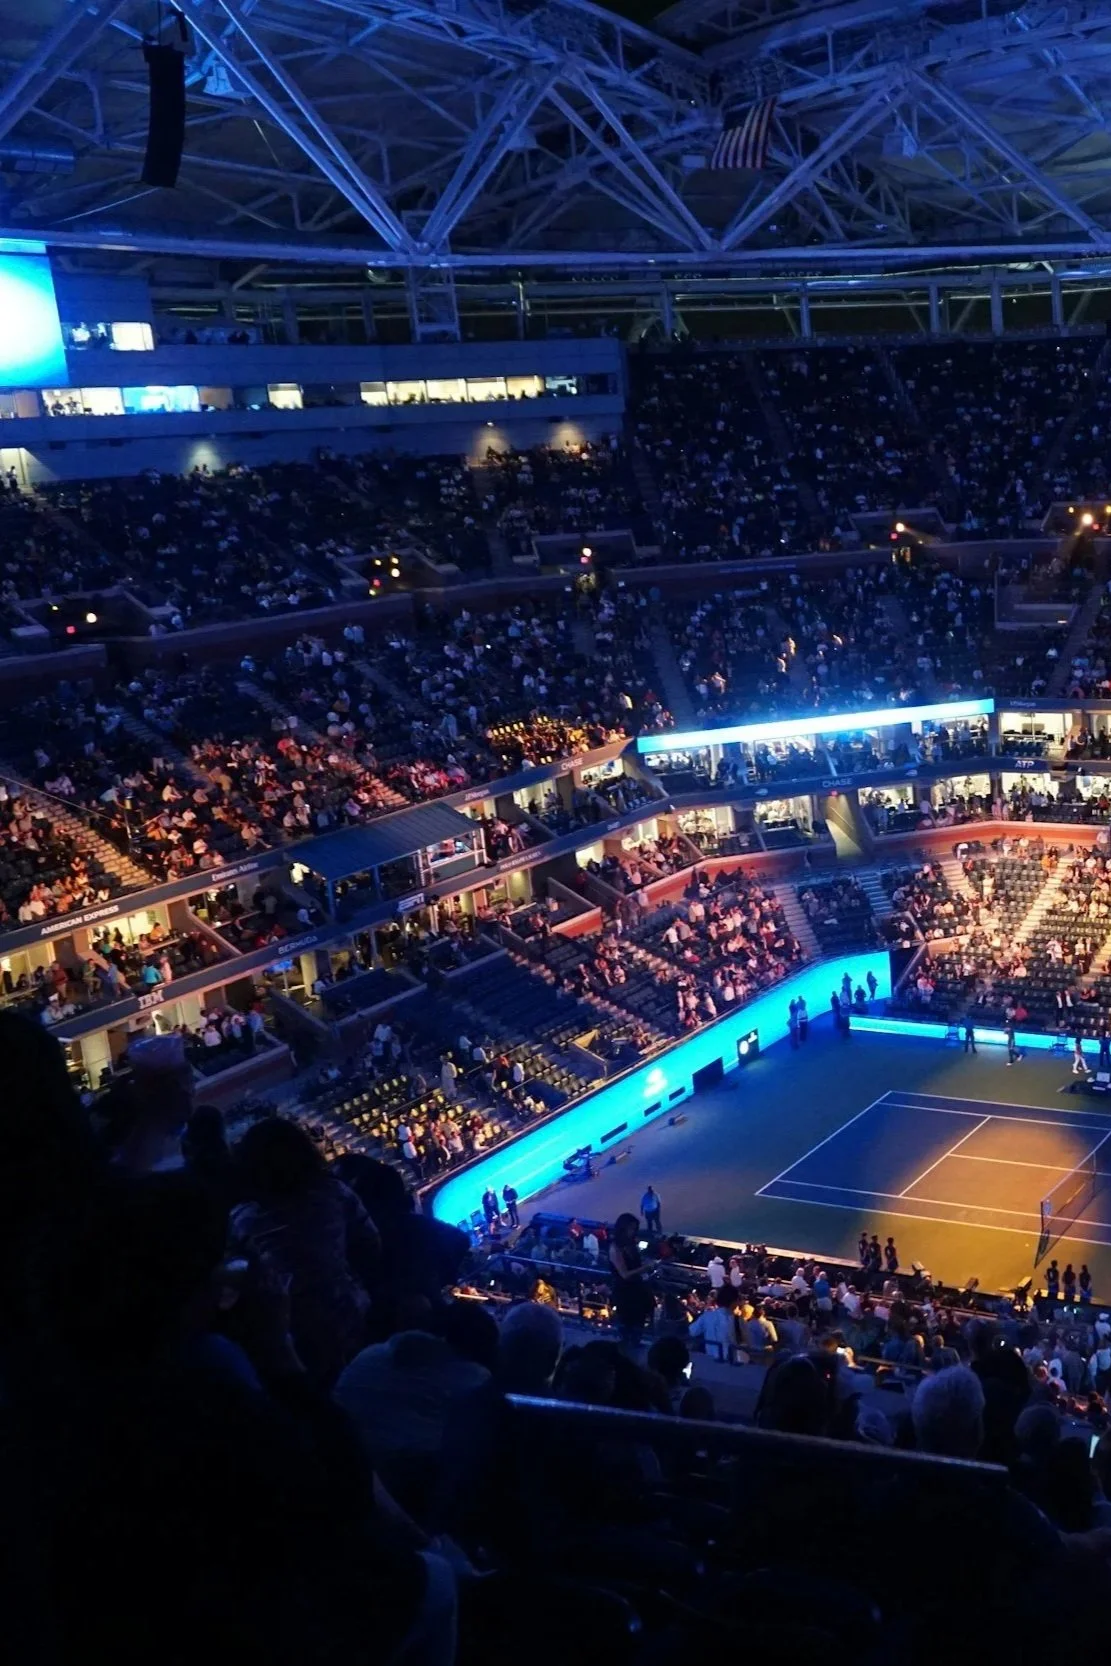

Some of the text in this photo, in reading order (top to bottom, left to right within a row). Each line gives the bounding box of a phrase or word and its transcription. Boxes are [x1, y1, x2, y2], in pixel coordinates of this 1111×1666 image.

[1014, 760, 1035, 769] ATP
[822, 778, 853, 788] CHASE
[41, 904, 120, 935] AMERICAN EXPRESS
[278, 935, 319, 954] BERMUDA
[138, 989, 165, 1010] IBM
